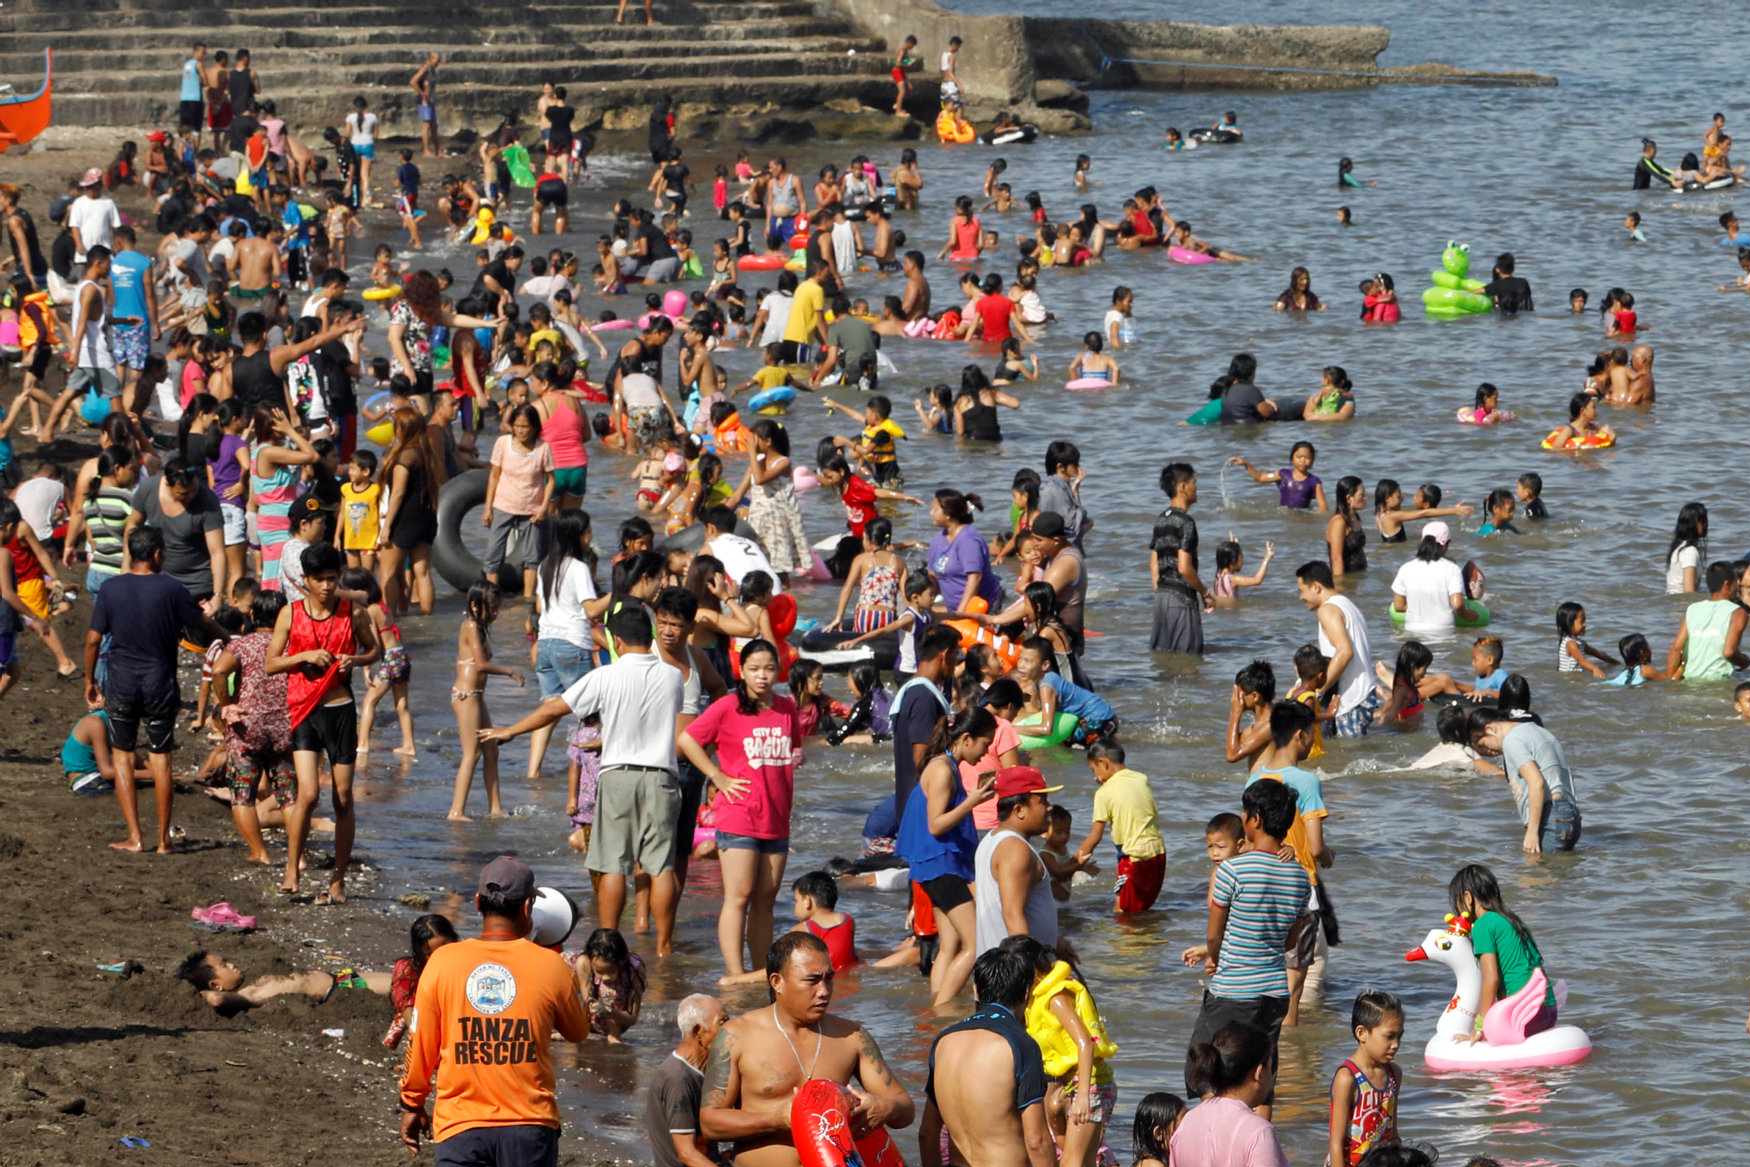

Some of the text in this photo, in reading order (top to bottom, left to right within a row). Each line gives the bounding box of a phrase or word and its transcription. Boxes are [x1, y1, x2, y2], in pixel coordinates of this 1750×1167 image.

[752, 727, 782, 737] CITY OF
[458, 1016, 531, 1042] TANZA
[455, 1041, 538, 1065] RESCUE
